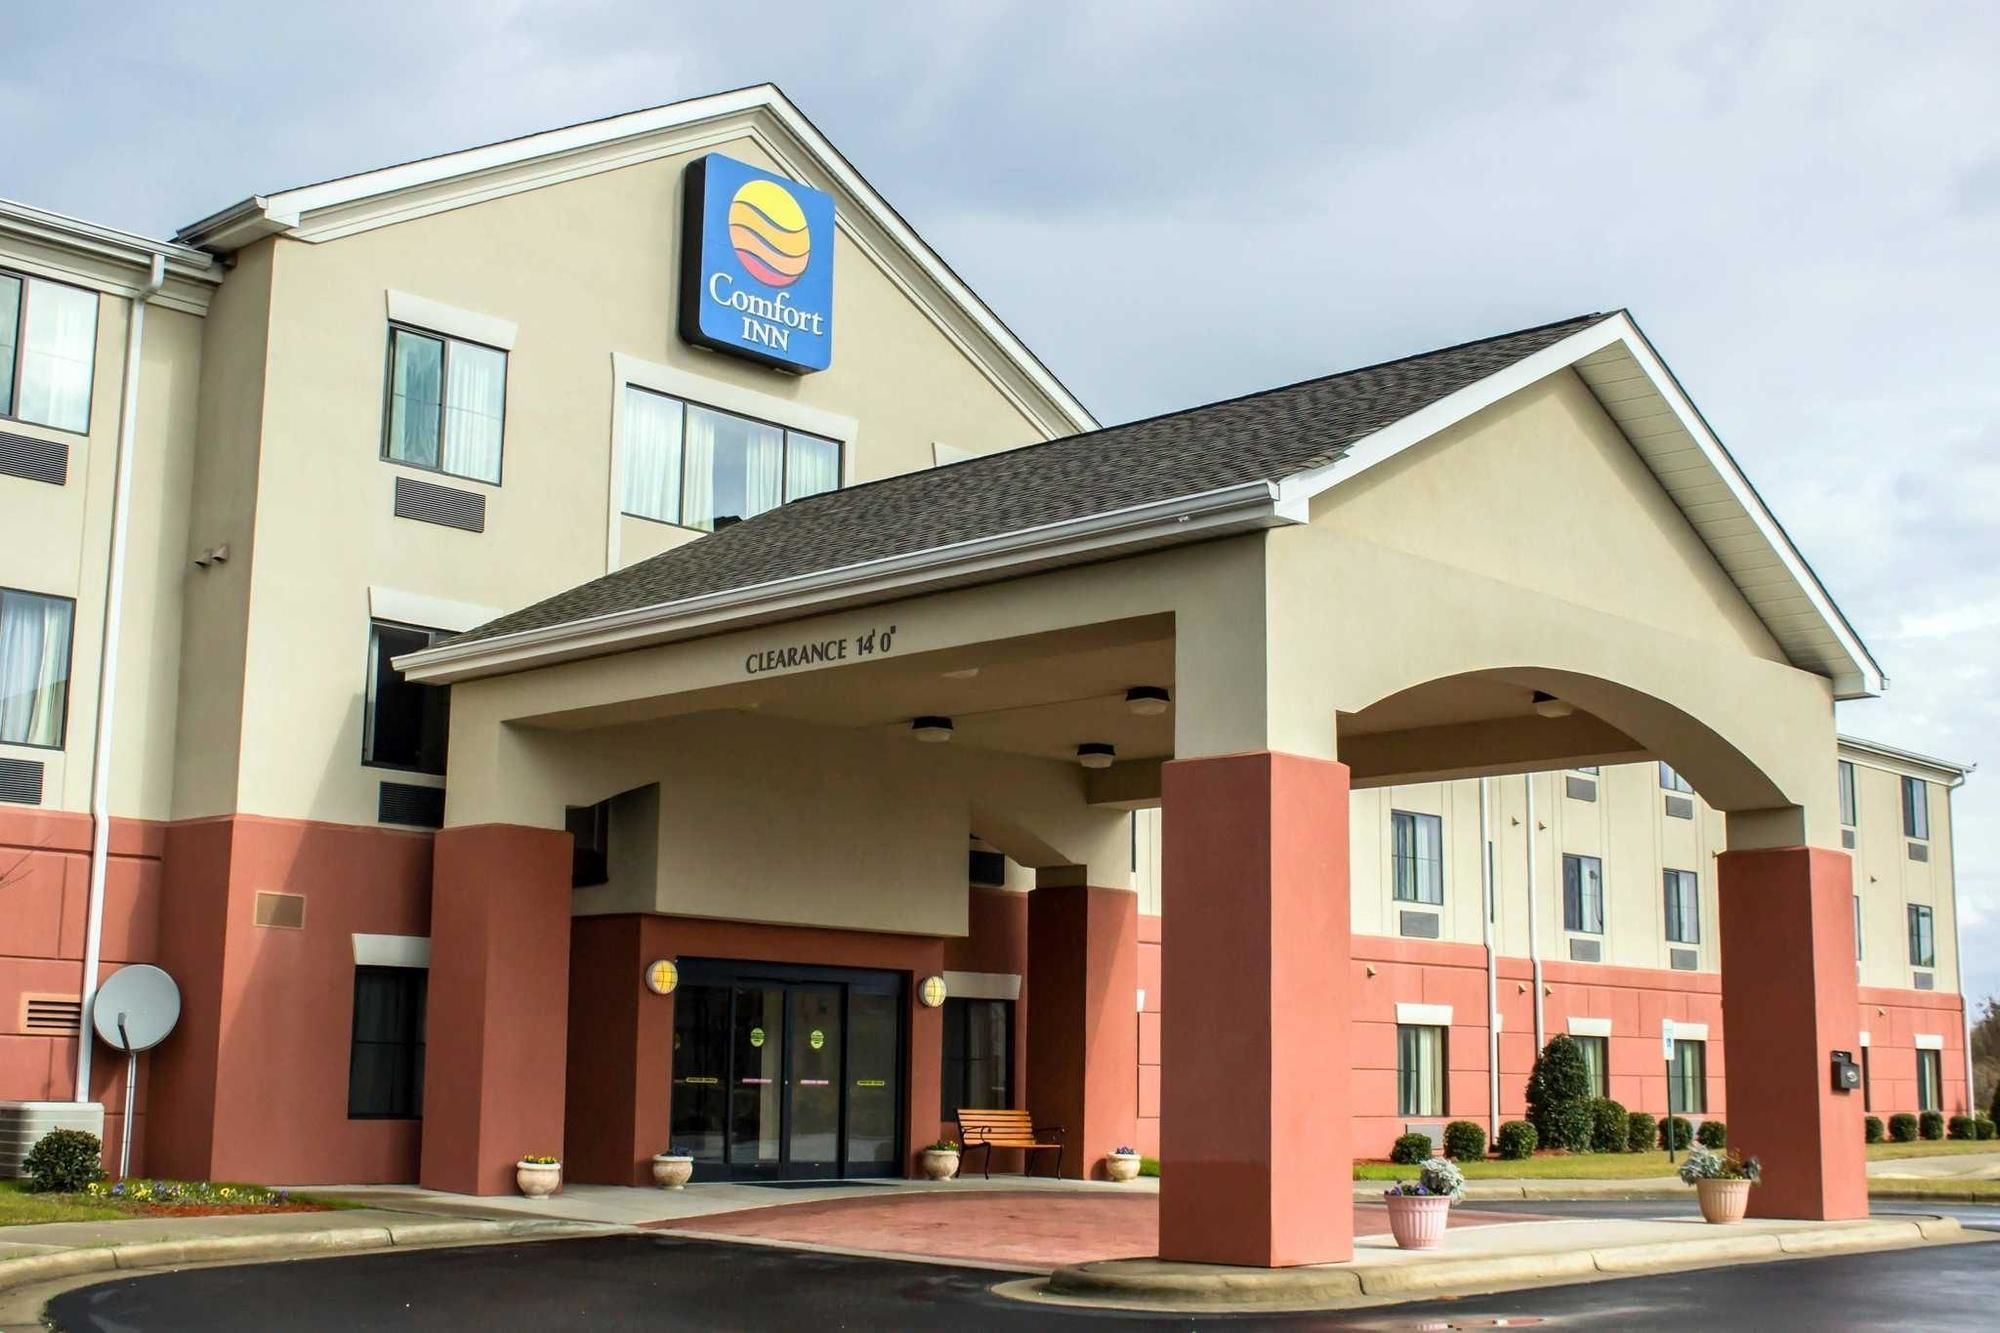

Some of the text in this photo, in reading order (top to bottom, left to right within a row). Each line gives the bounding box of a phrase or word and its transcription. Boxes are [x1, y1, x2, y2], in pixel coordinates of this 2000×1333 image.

[709, 272, 824, 336] Comfort
[741, 317, 790, 351] INN
[745, 638, 847, 674] CLEARANCE
